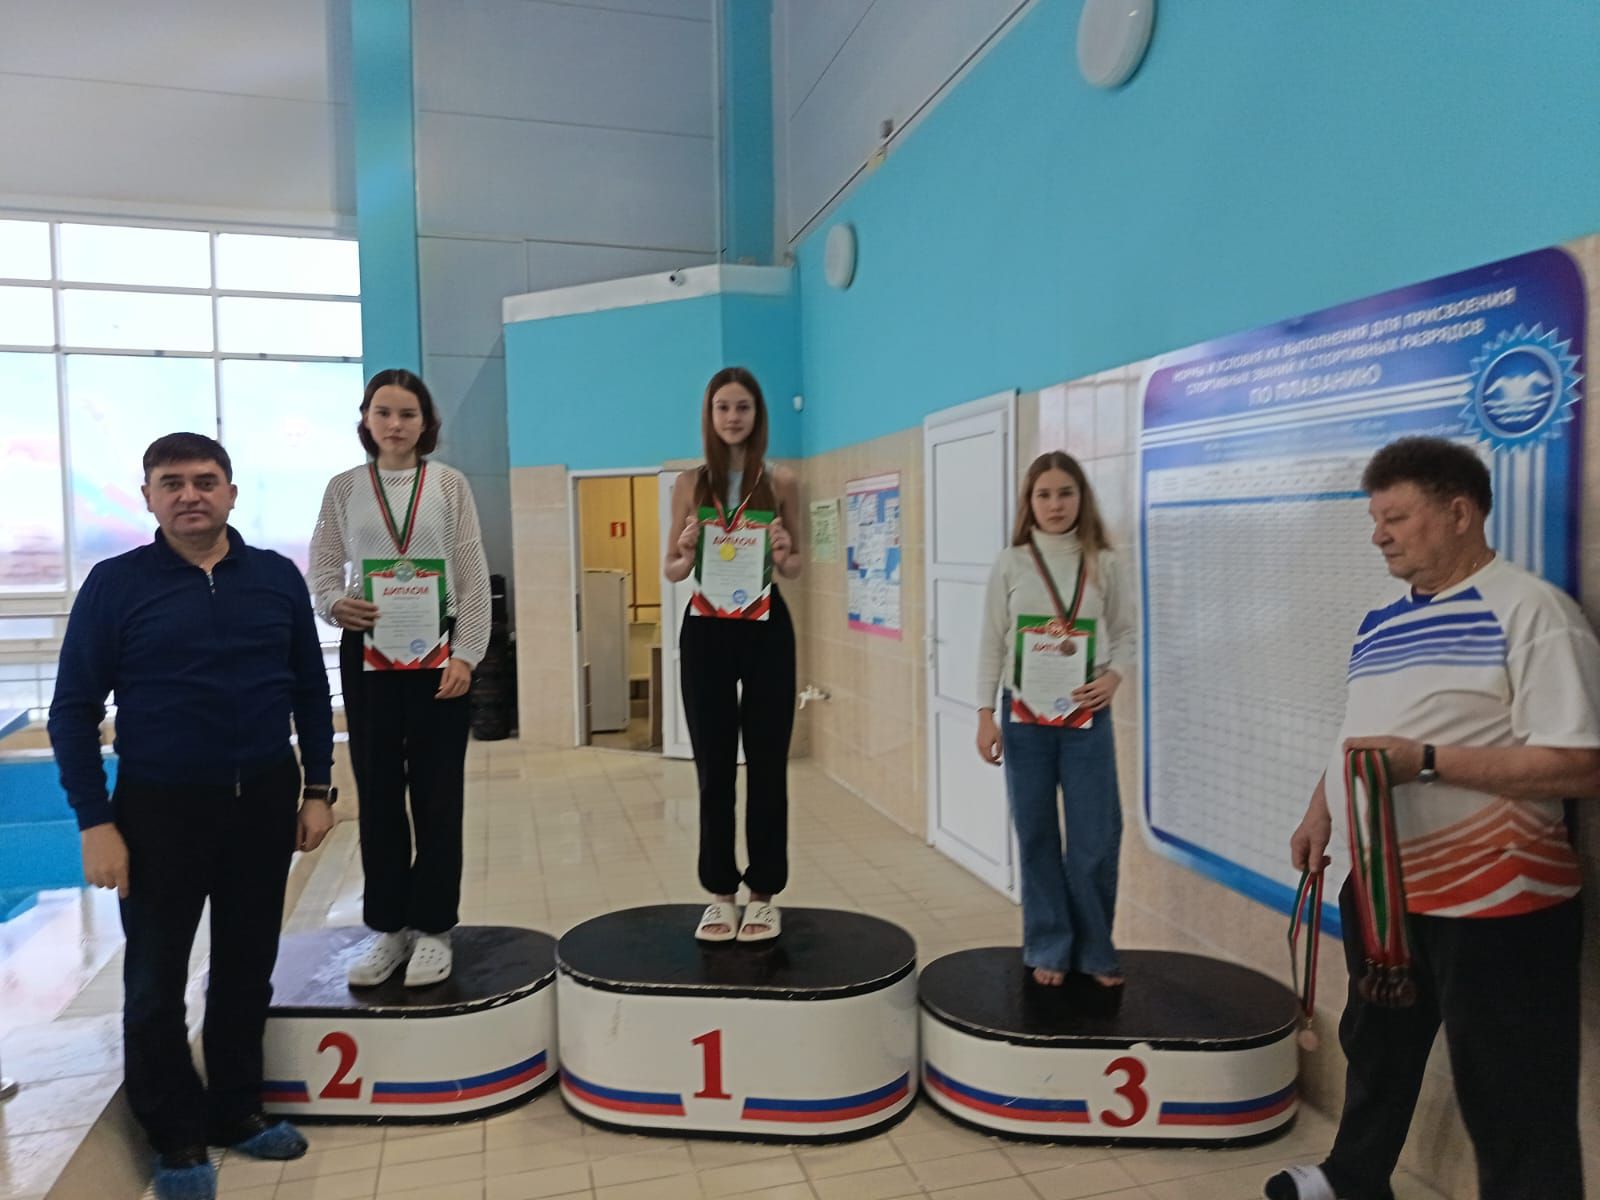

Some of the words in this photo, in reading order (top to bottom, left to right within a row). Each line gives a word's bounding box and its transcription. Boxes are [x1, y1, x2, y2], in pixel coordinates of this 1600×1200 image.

[1368, 315, 1401, 339] ДЛЯ
[1402, 287, 1516, 330] ПРИСВОЕНИЯ
[1400, 317, 1486, 350] РАЗРЯДОВ
[1249, 385, 1273, 406] ПО
[1275, 363, 1382, 401] ПЛАВАНИЮ
[713, 536, 757, 545] ДИПЛОМ
[383, 587, 429, 596] ДИПЛОМ
[318, 1031, 363, 1099] 2
[691, 1029, 731, 1099] 1
[1100, 1056, 1149, 1127] 3
